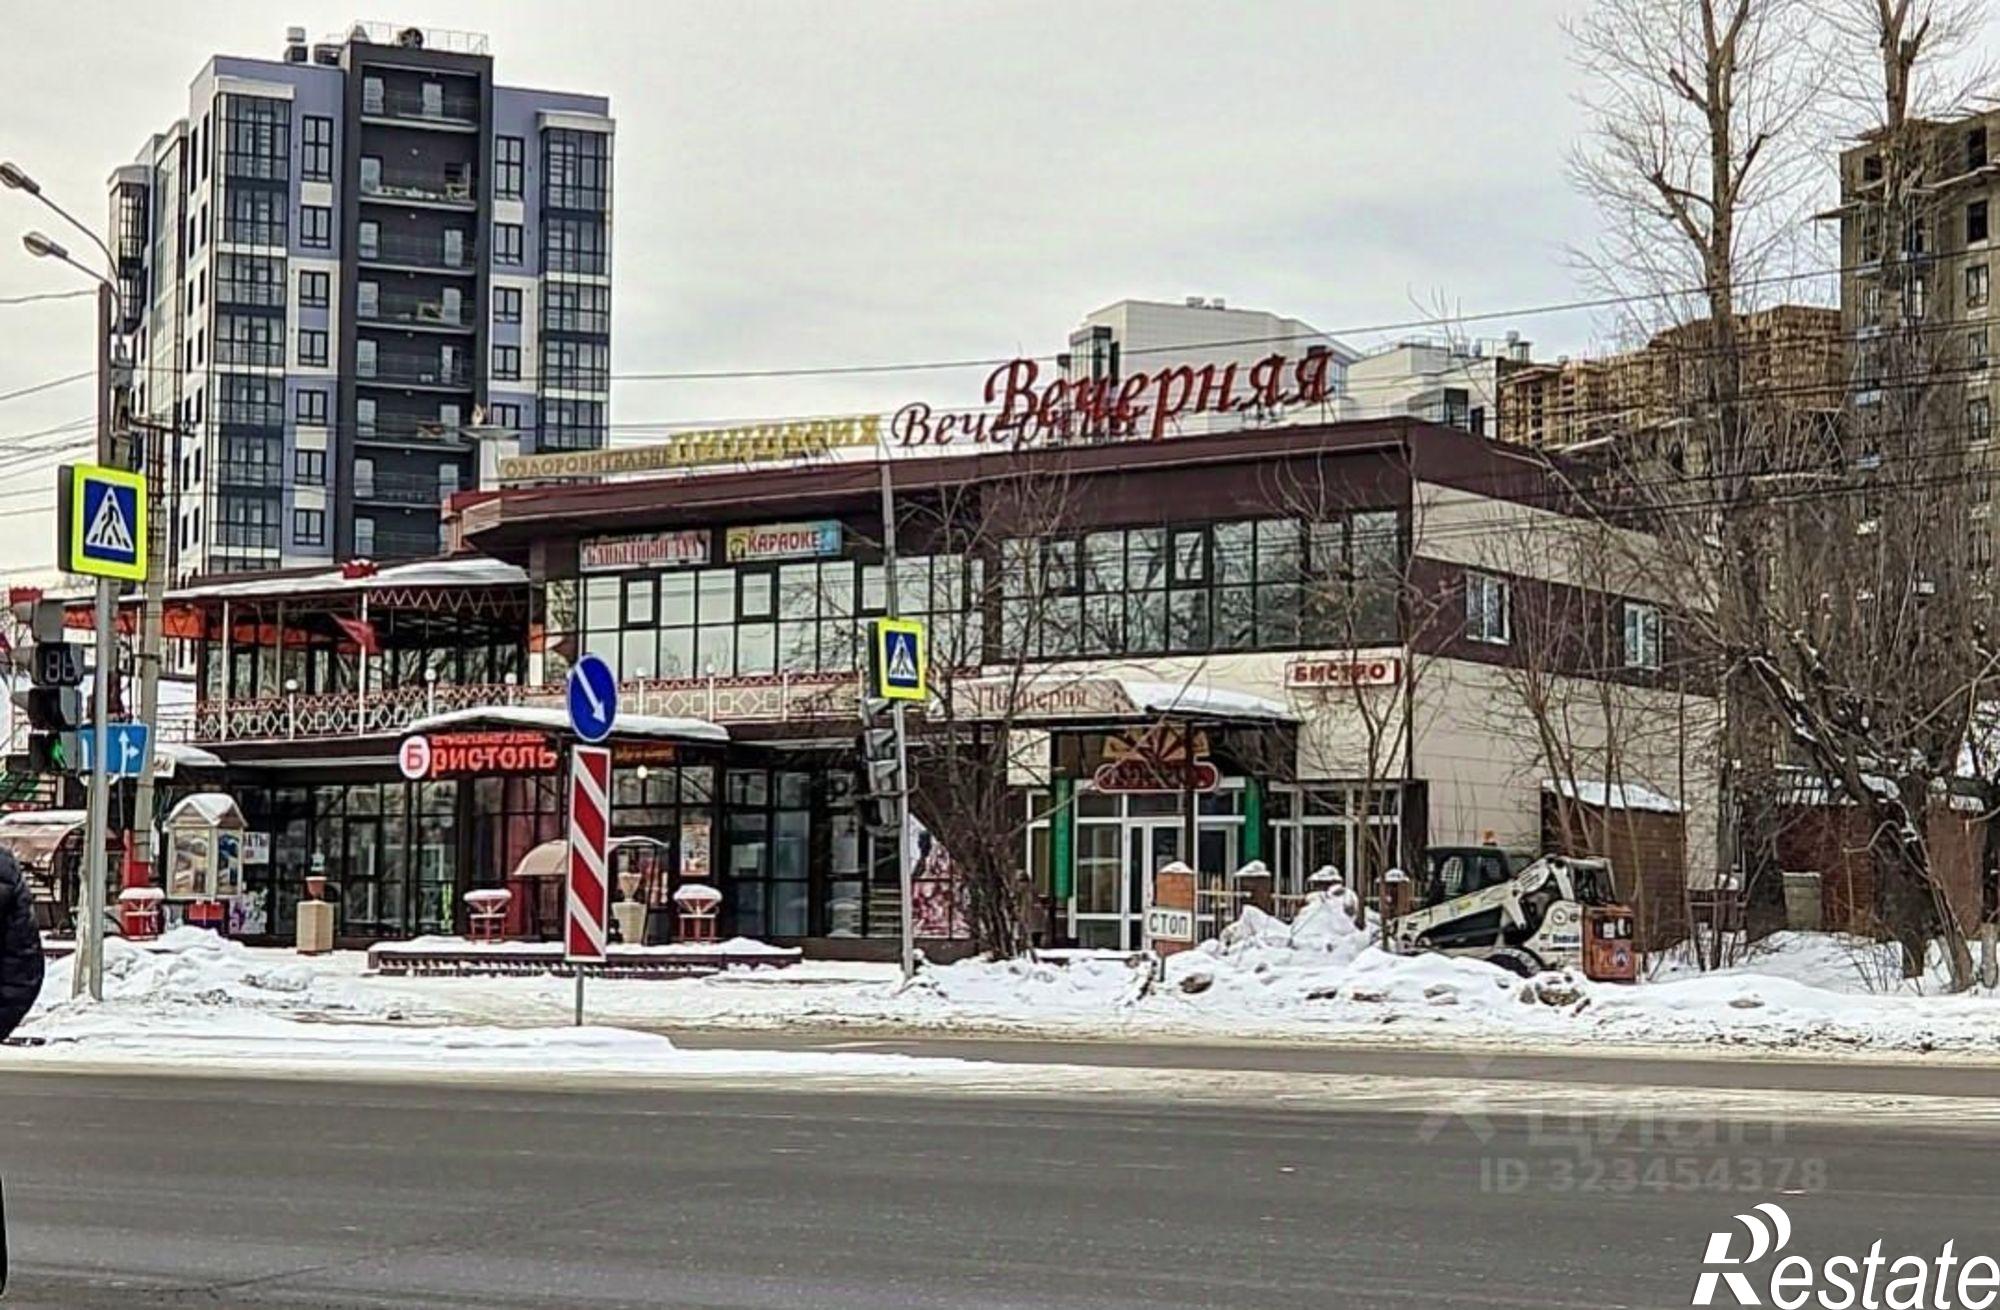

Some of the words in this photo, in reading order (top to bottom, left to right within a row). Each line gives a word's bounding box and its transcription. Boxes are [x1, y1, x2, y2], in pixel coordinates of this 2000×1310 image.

[984, 349, 1337, 441] Вечерняя
[748, 530, 822, 553] КАРАОКЕ
[1294, 662, 1387, 683] БИСТРО
[400, 735, 559, 779] Бристоль
[1149, 912, 1188, 935] СТОП
